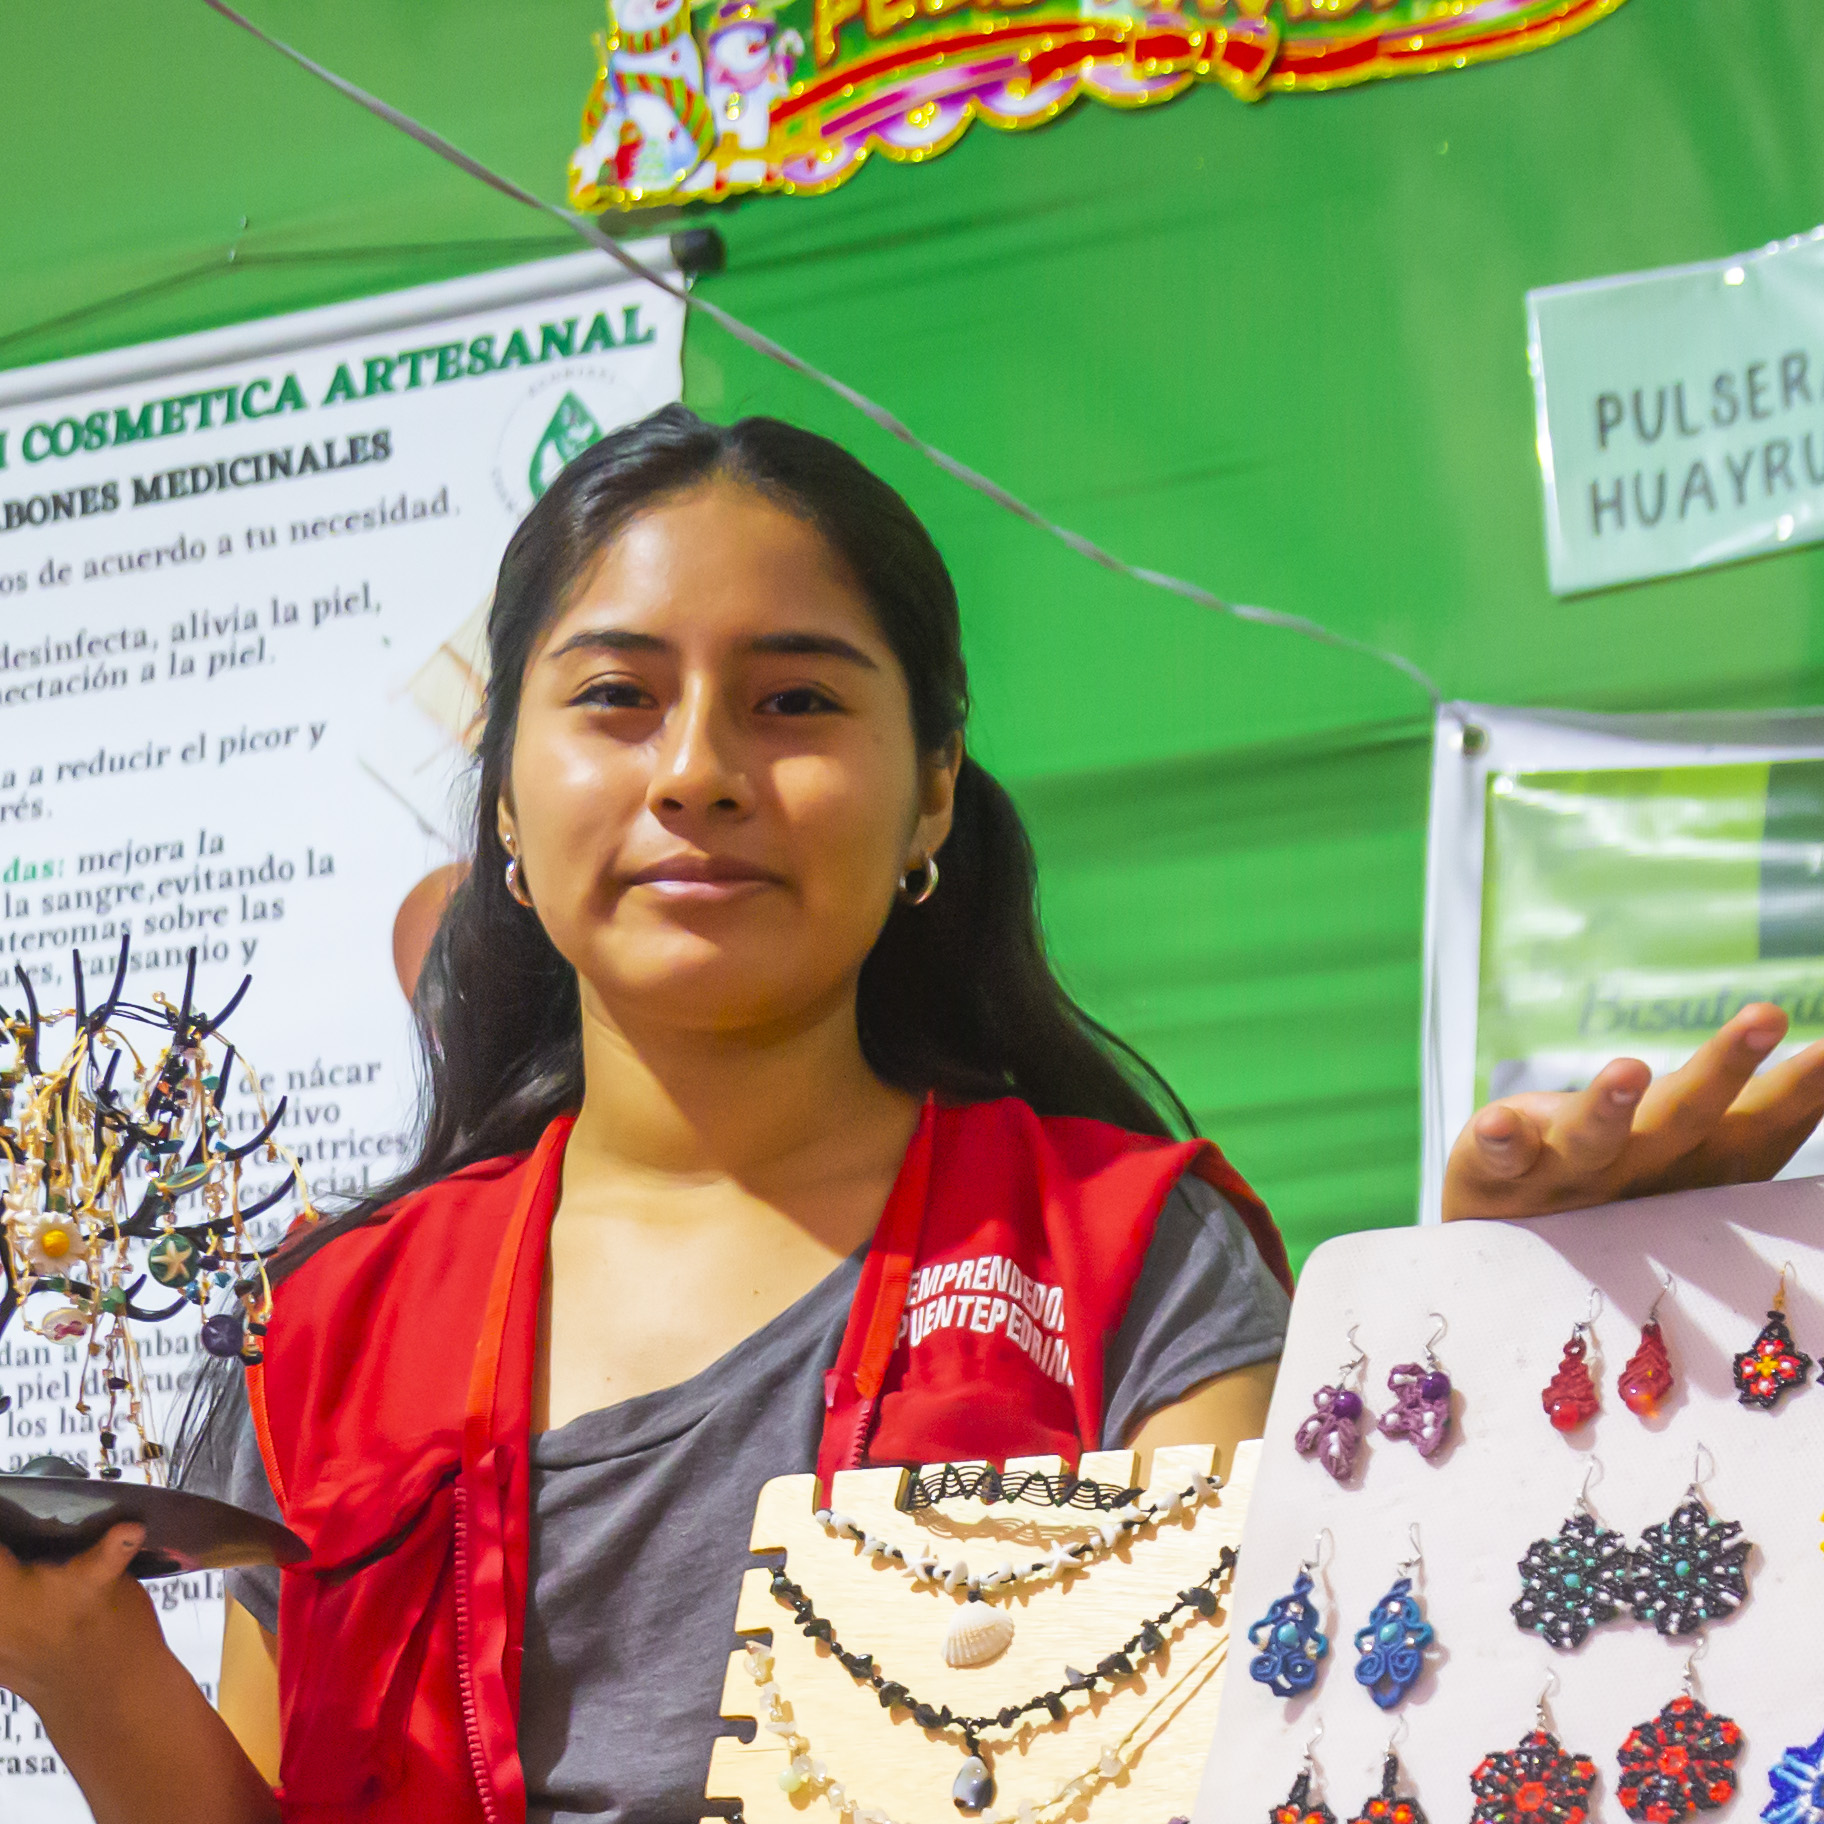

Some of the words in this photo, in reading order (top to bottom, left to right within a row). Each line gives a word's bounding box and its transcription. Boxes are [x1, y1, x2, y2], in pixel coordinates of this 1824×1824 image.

[20, 371, 305, 464] COSMETICA
[324, 302, 654, 404] ARTESANAL
[131, 426, 392, 508] MEDICINALES
[37, 561, 72, 590] de
[82, 536, 206, 581] acuerdo
[217, 535, 232, 556] a
[244, 527, 276, 552] tu
[170, 606, 258, 644] alivia
[270, 599, 298, 627] la
[312, 583, 382, 628] piel,
[140, 662, 156, 682] a
[168, 651, 195, 677] la
[28, 766, 44, 786] a
[56, 741, 170, 781] reducir
[180, 733, 206, 762] el
[218, 727, 298, 764] picor
[308, 722, 326, 751] y
[77, 841, 184, 875] mejora
[196, 830, 224, 857] la
[3, 894, 29, 919] la
[306, 852, 334, 878] la
[143, 902, 228, 935] sobre
[239, 895, 284, 922] las
[906, 1255, 1065, 1332] EMPRENDEDO
